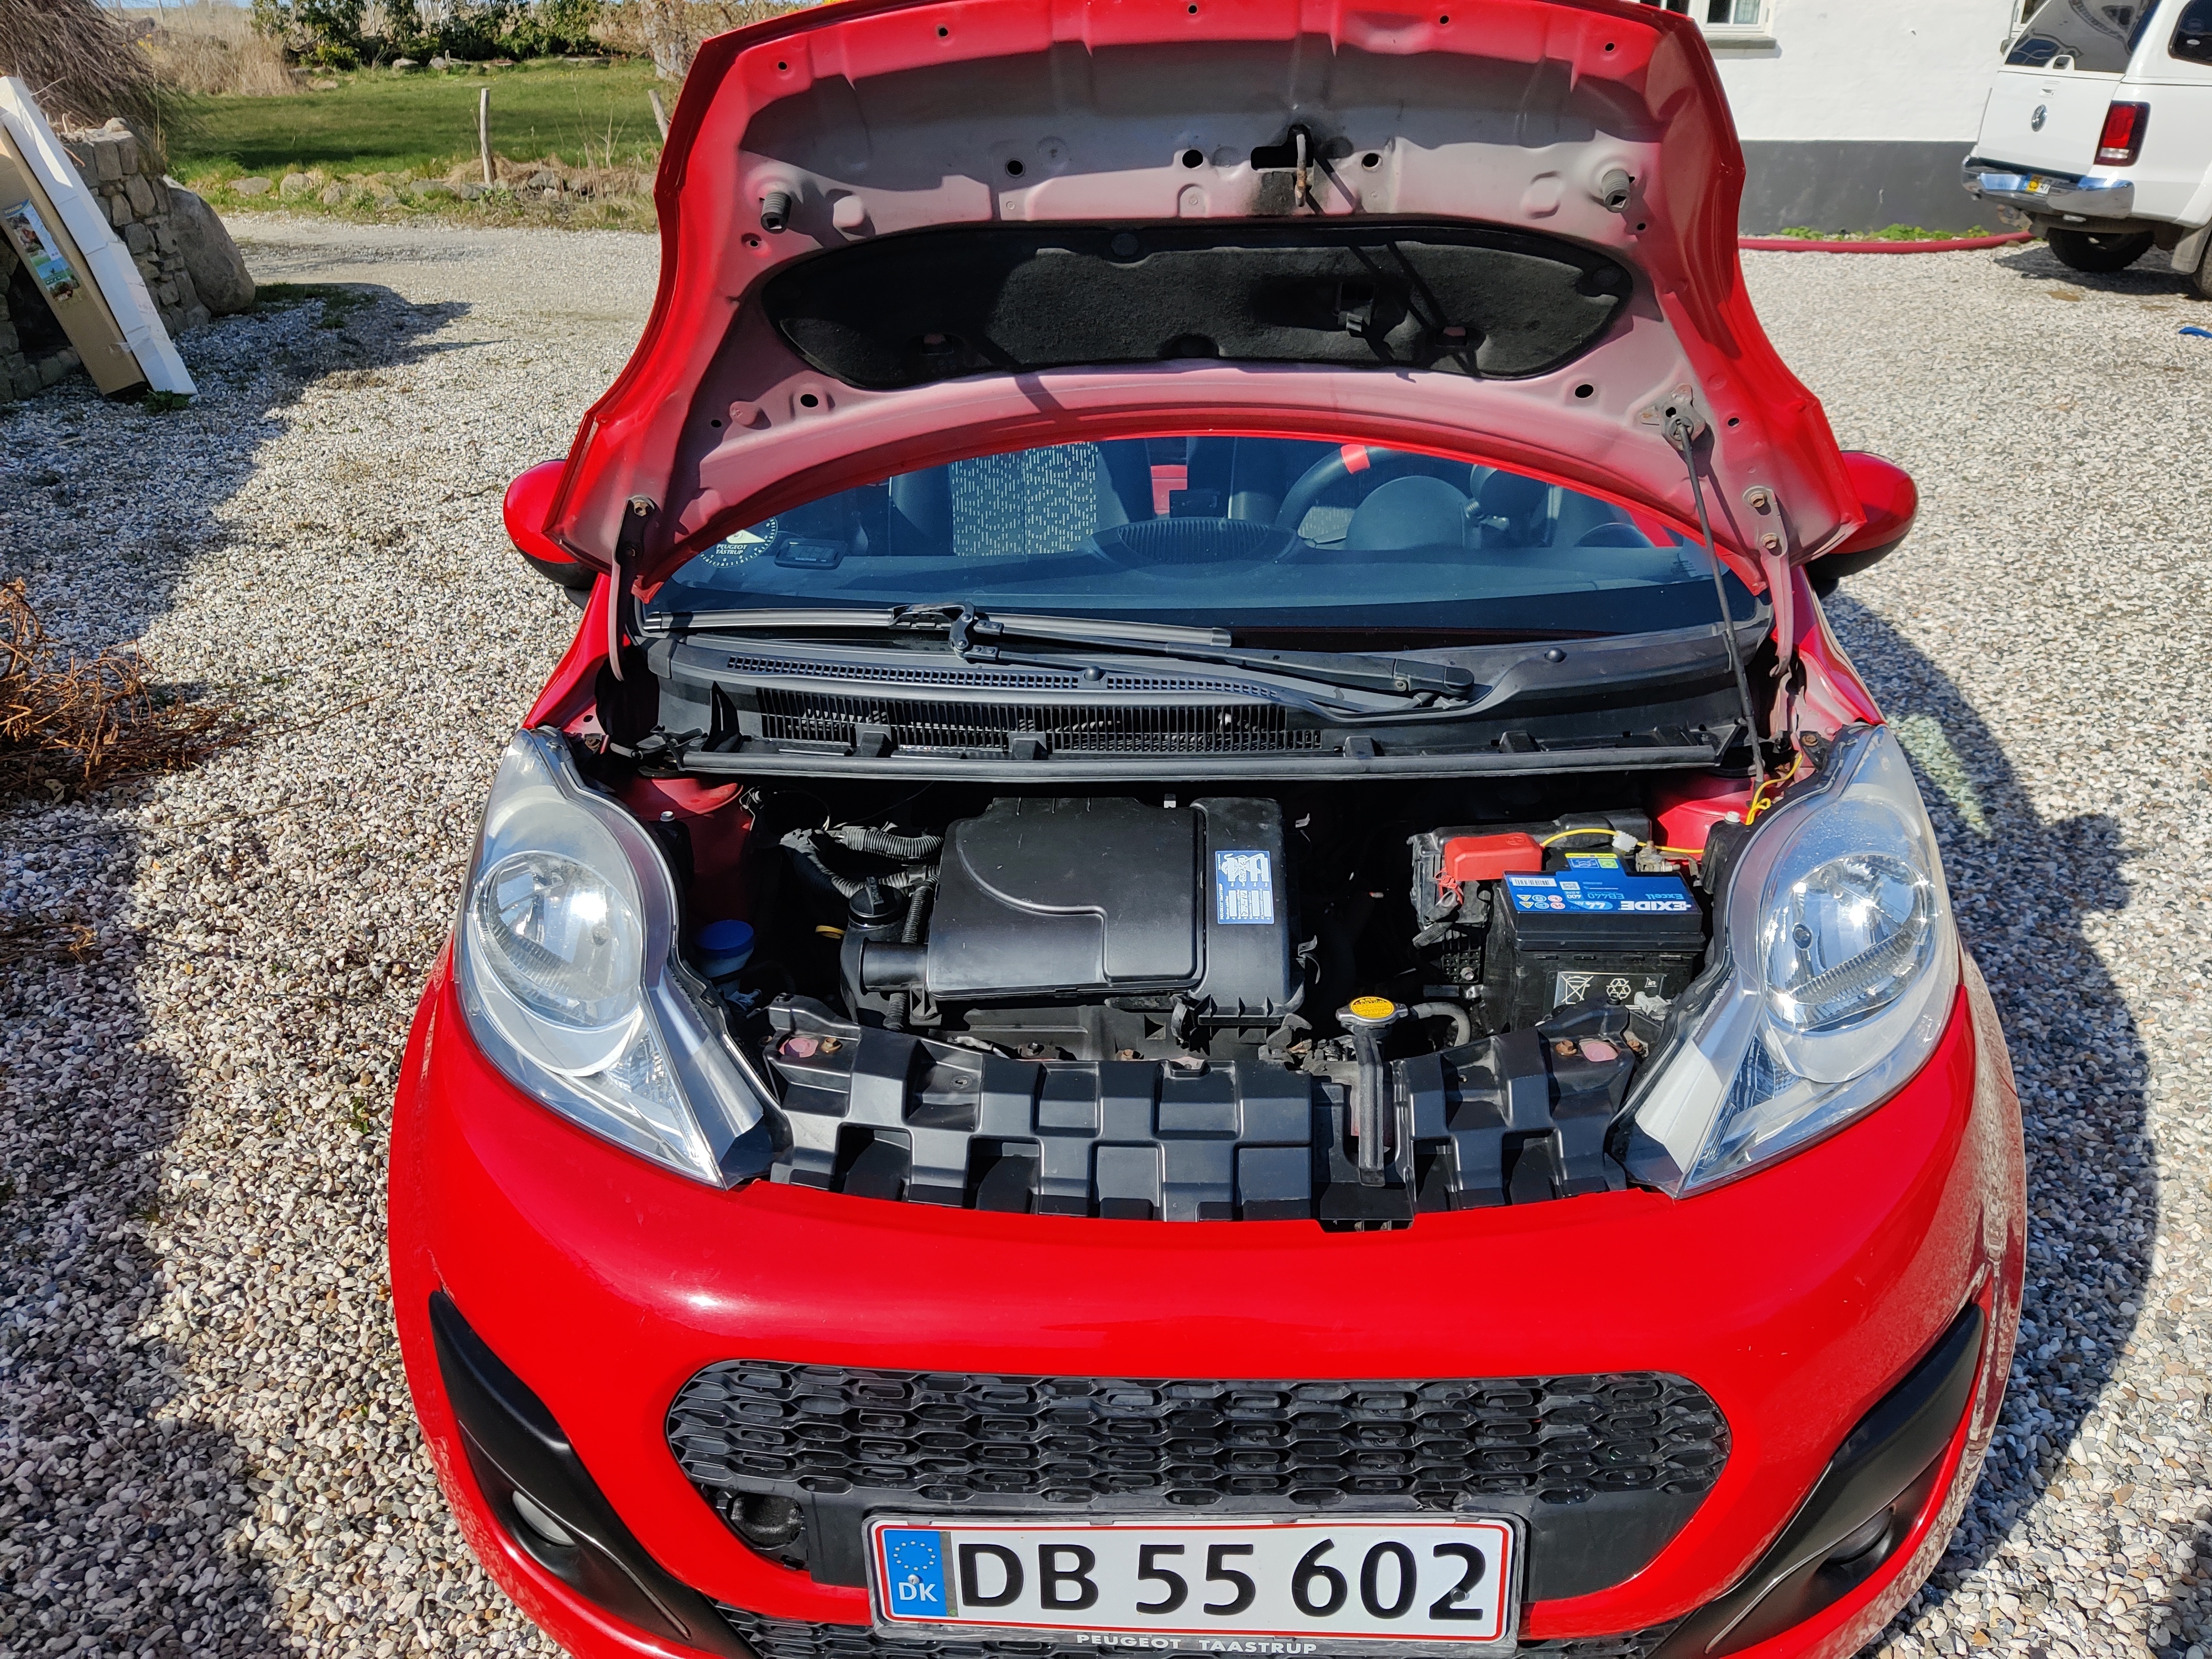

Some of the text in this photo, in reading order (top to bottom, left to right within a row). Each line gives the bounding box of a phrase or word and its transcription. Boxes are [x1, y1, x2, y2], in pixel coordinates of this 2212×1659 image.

[1621, 901, 1690, 911] EXIDE
[958, 1538, 1486, 1620] DB 55 602
[898, 1582, 938, 1602] DK
[1077, 1634, 1317, 1655] PEUGEOT TAASTRUP
